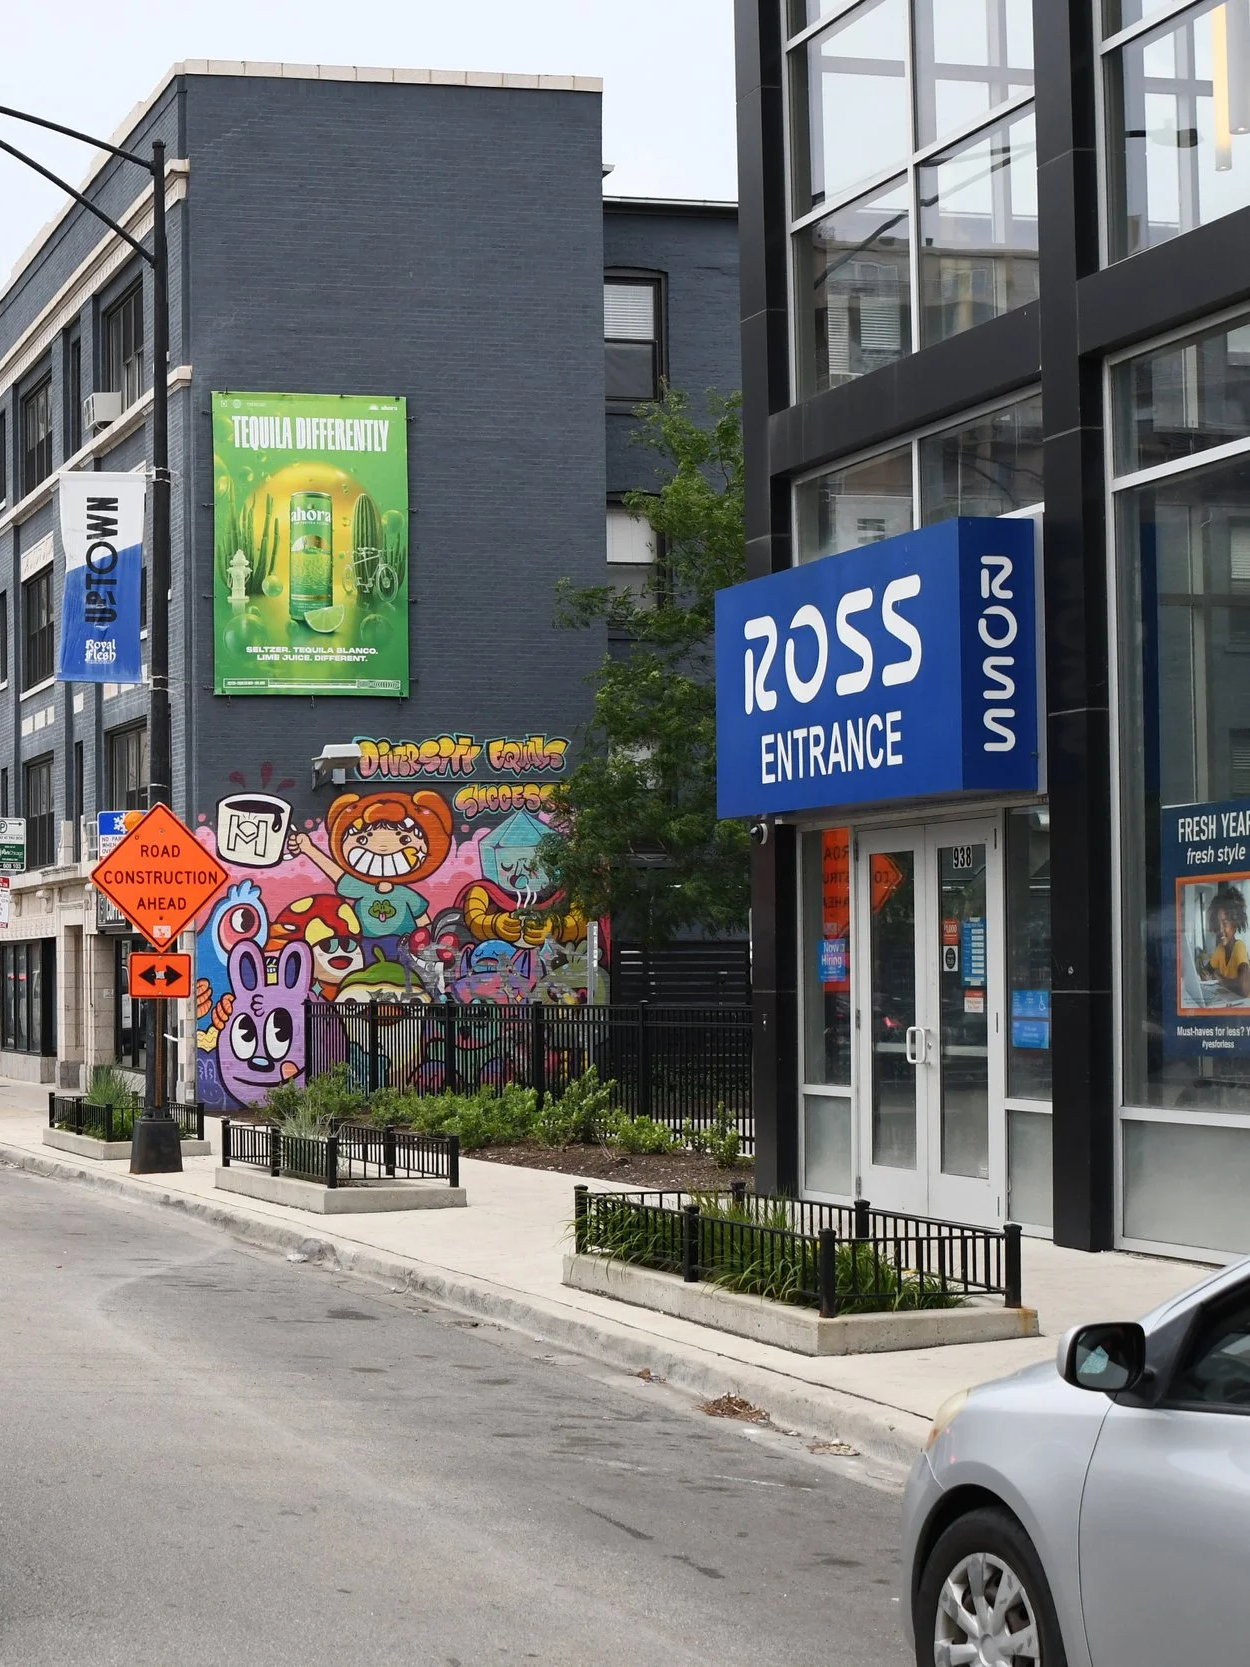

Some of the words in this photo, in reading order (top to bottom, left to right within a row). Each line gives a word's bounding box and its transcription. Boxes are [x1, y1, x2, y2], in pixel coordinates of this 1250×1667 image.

[232, 416, 292, 450] TEQUILA
[296, 418, 389, 452] DIFFERENTLY
[291, 506, 330, 522] ahora
[84, 497, 118, 624] UPTOWN
[86, 639, 116, 652] Royal
[744, 574, 922, 715] ROSS
[85, 650, 116, 662] Flesh
[315, 654, 368, 662] DIFFERENT.
[978, 555, 1018, 752] ROSS
[762, 711, 902, 784] ENTRANCE
[1178, 814, 1216, 843] FRESH
[141, 845, 180, 857] ROAD
[953, 846, 971, 868] 938
[1187, 846, 1214, 864] fresh
[1217, 843, 1246, 865] style
[104, 871, 217, 884] CONSTRUCTION
[137, 898, 186, 910] AHEAD
[824, 942, 839, 952] Now
[822, 954, 842, 968] Hiring
[1177, 1026, 1213, 1036] Must-haves
[1215, 1026, 1225, 1036] for
[1227, 1026, 1244, 1036] less?
